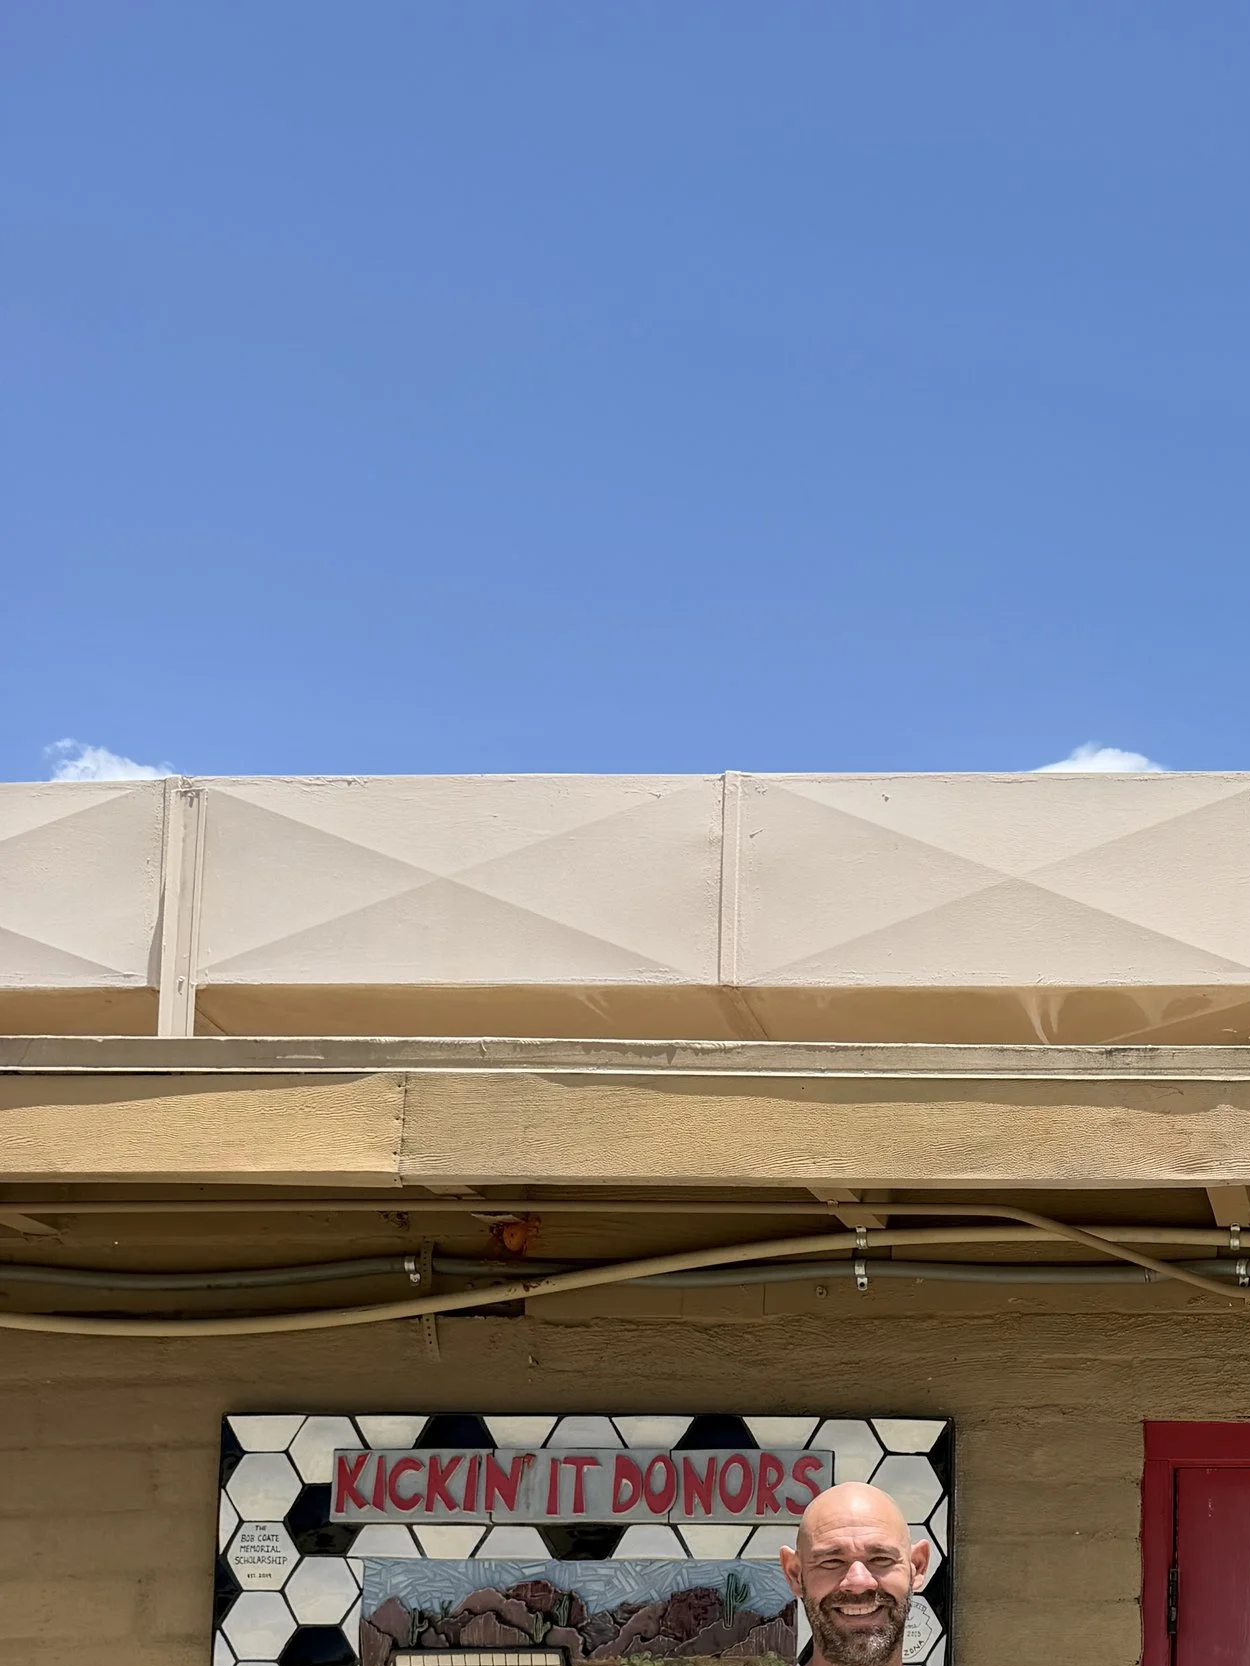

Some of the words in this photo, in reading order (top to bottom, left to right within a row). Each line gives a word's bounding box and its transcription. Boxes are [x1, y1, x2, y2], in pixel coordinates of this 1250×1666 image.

[336, 1453, 536, 1515] KICKIN'
[546, 1456, 602, 1516] IT
[612, 1454, 824, 1517] DONORS
[240, 1545, 280, 1553] MEMORIAL
[235, 1556, 288, 1565] SCHOLARSHIP
